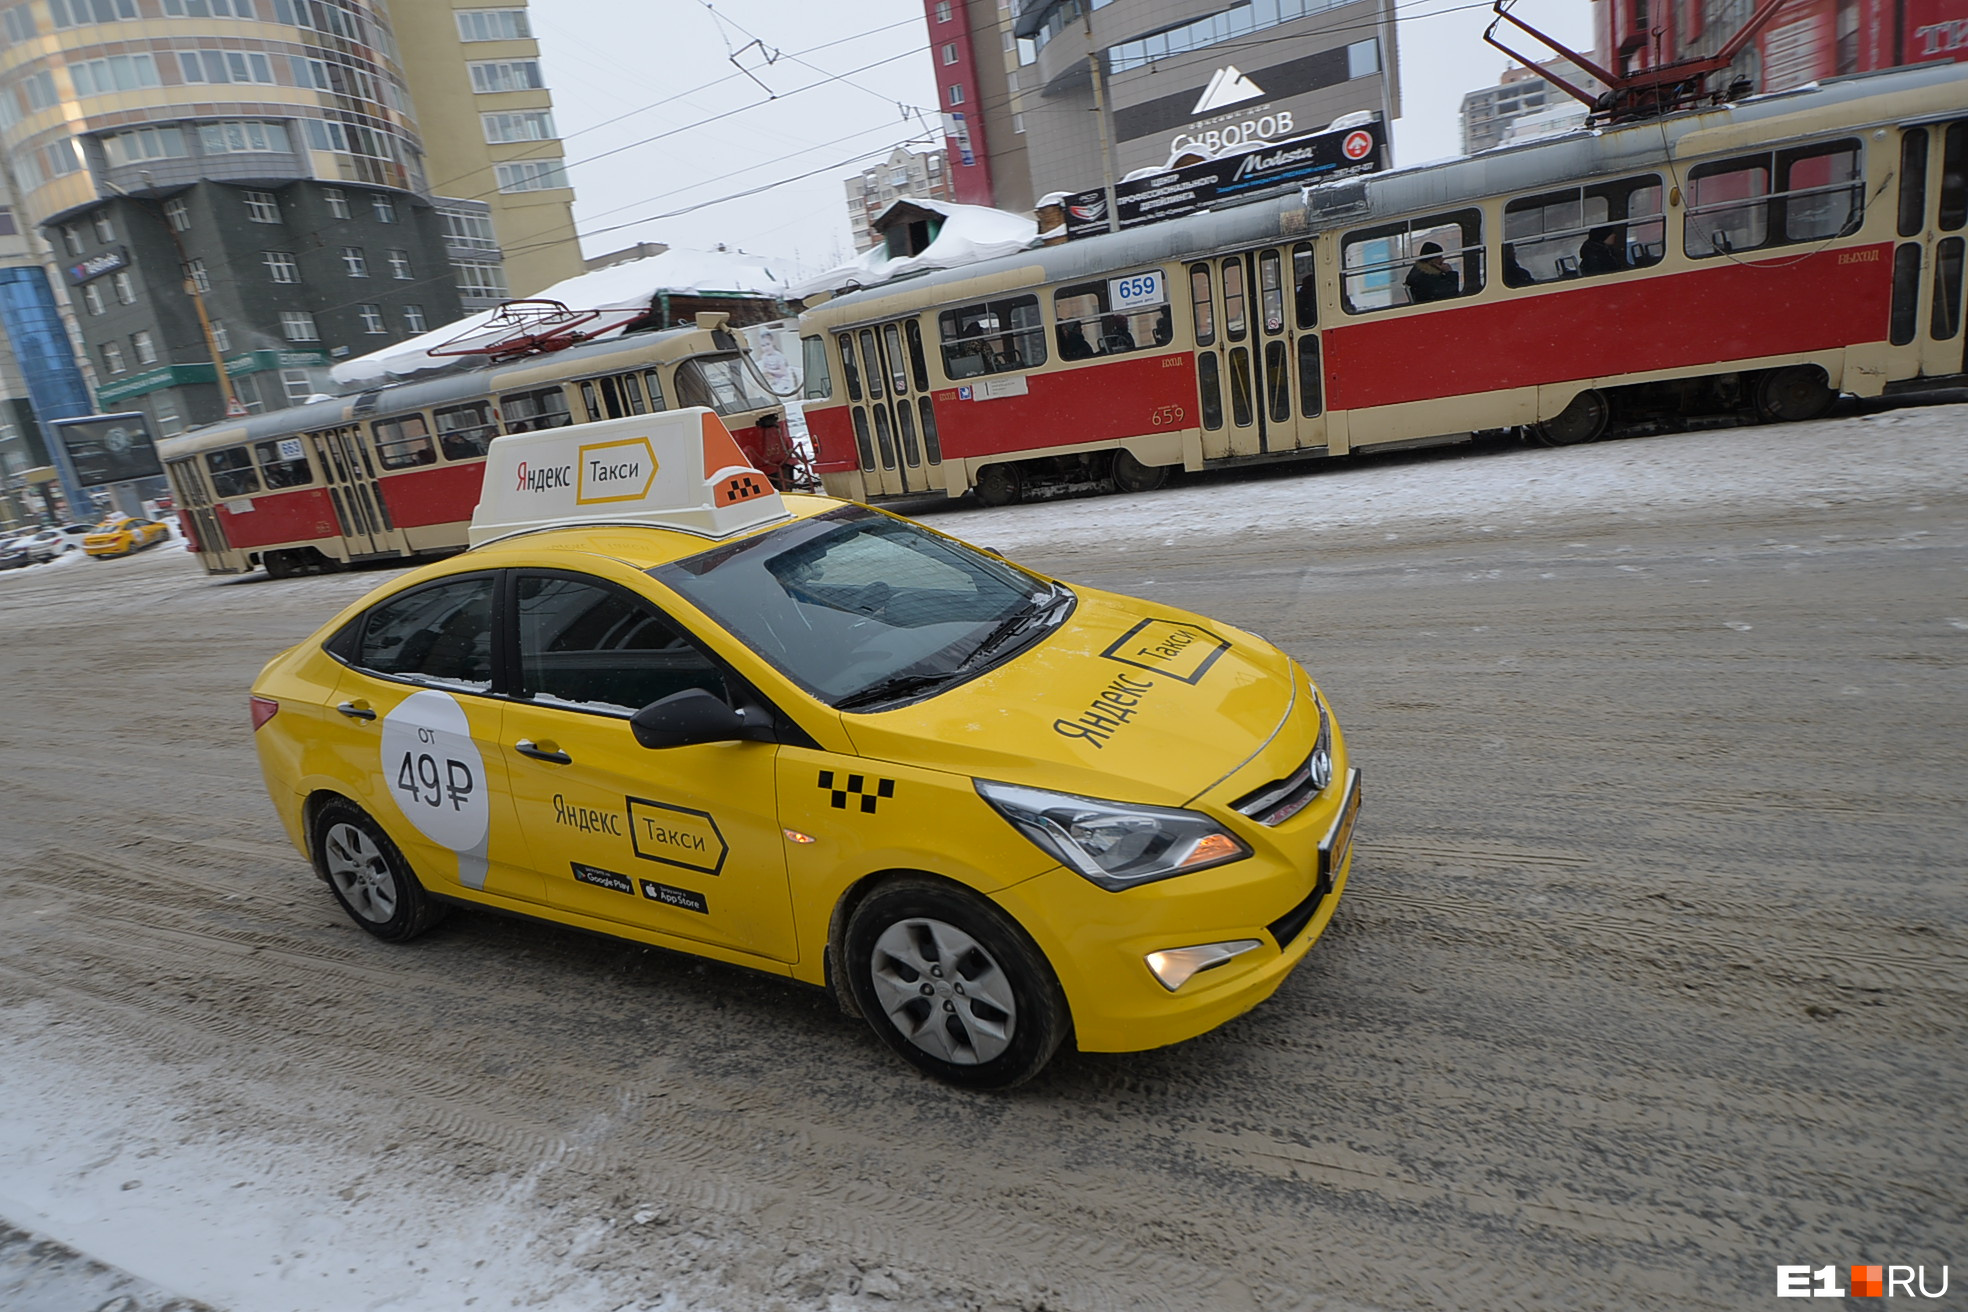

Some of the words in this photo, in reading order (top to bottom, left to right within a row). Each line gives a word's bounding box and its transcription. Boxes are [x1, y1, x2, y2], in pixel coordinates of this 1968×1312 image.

[1838, 249, 1879, 265] ВЫХОД
[1119, 276, 1155, 299] 659
[1152, 407, 1185, 426] 659
[516, 461, 571, 493] Яндекс
[590, 460, 639, 482] Такси
[1052, 673, 1154, 750] Яндекс
[1137, 629, 1198, 662] Такси
[553, 793, 622, 837] Яндекс
[642, 817, 706, 852] Такси
[587, 872, 614, 887] Google
[613, 879, 630, 892] Play
[660, 891, 678, 904] App
[678, 895, 700, 909] Store
